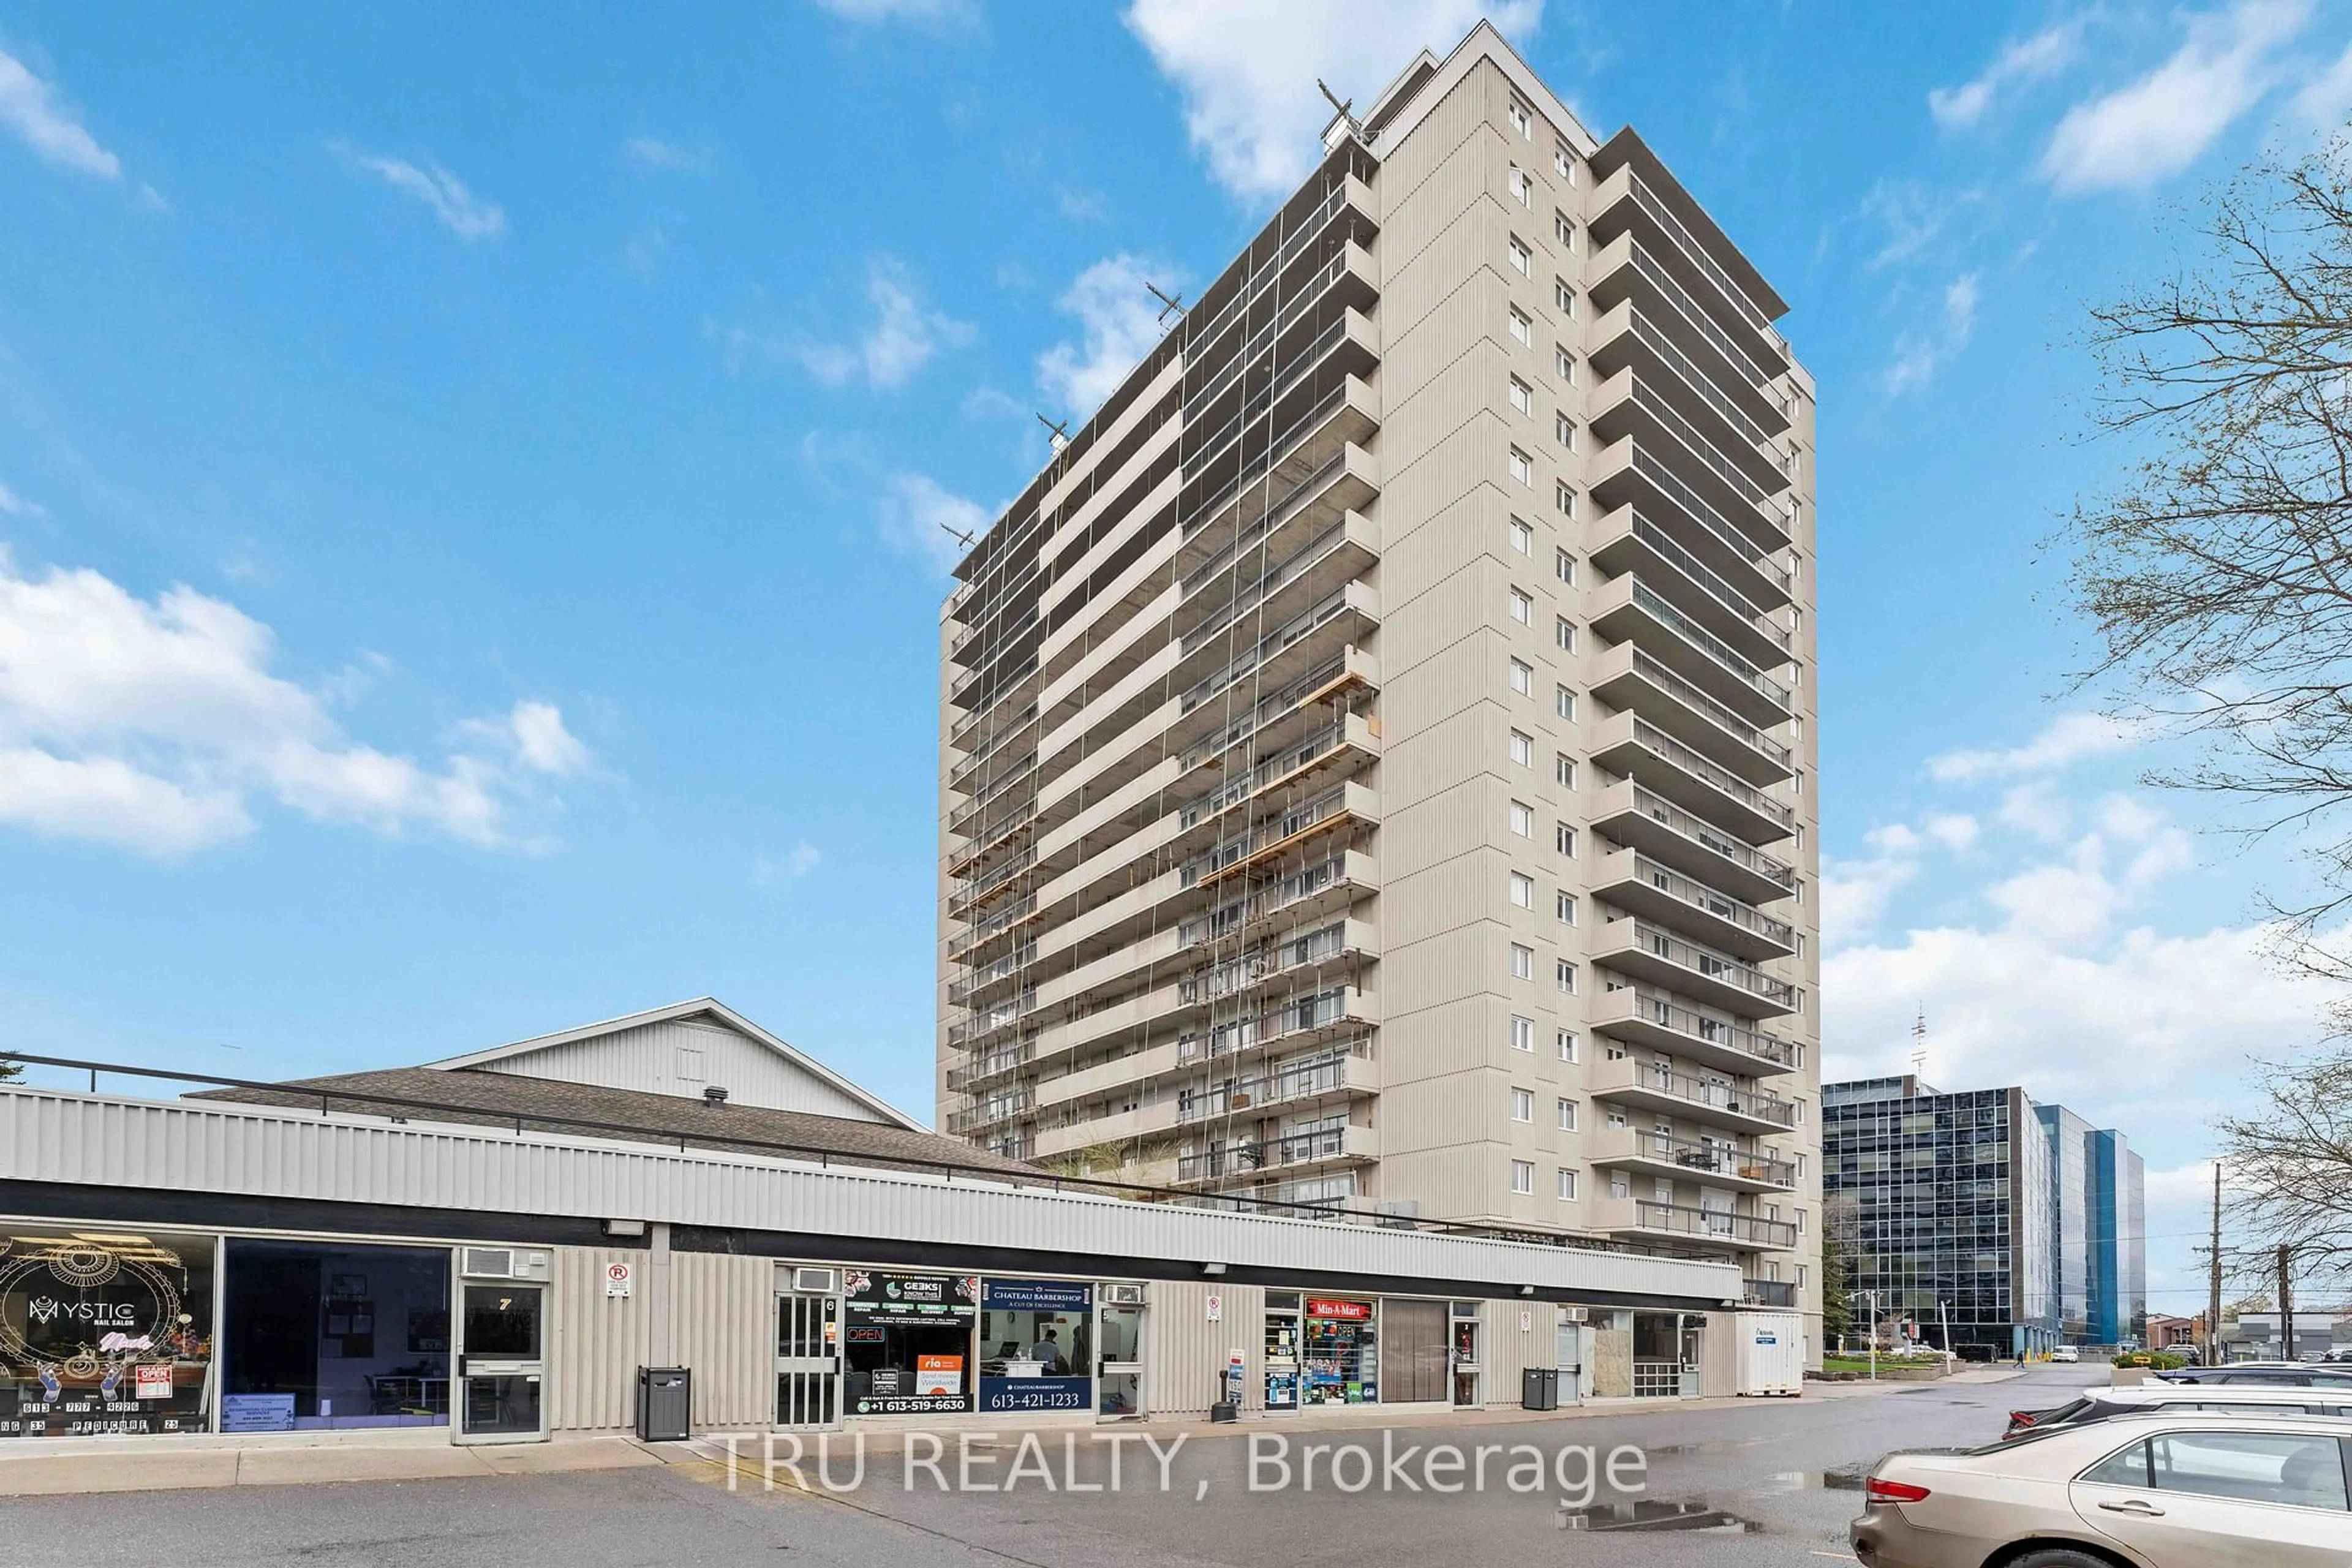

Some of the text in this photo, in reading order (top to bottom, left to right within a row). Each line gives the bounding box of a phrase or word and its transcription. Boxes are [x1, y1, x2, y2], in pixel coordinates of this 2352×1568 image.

[499, 1298, 511, 1310] 7
[826, 1301, 834, 1310] 6
[1317, 1303, 1359, 1316] Min-A-Mart
[30, 1300, 134, 1322] MYSTIC
[848, 1329, 883, 1340] OPEN
[925, 1357, 941, 1368] ria
[871, 1400, 965, 1411] +1 613-519-6630
[992, 1393, 1079, 1408] 613-421-1233
[31, 1421, 45, 1430] 35
[73, 1420, 147, 1431] PEDICURE
[165, 1420, 178, 1428] 25
